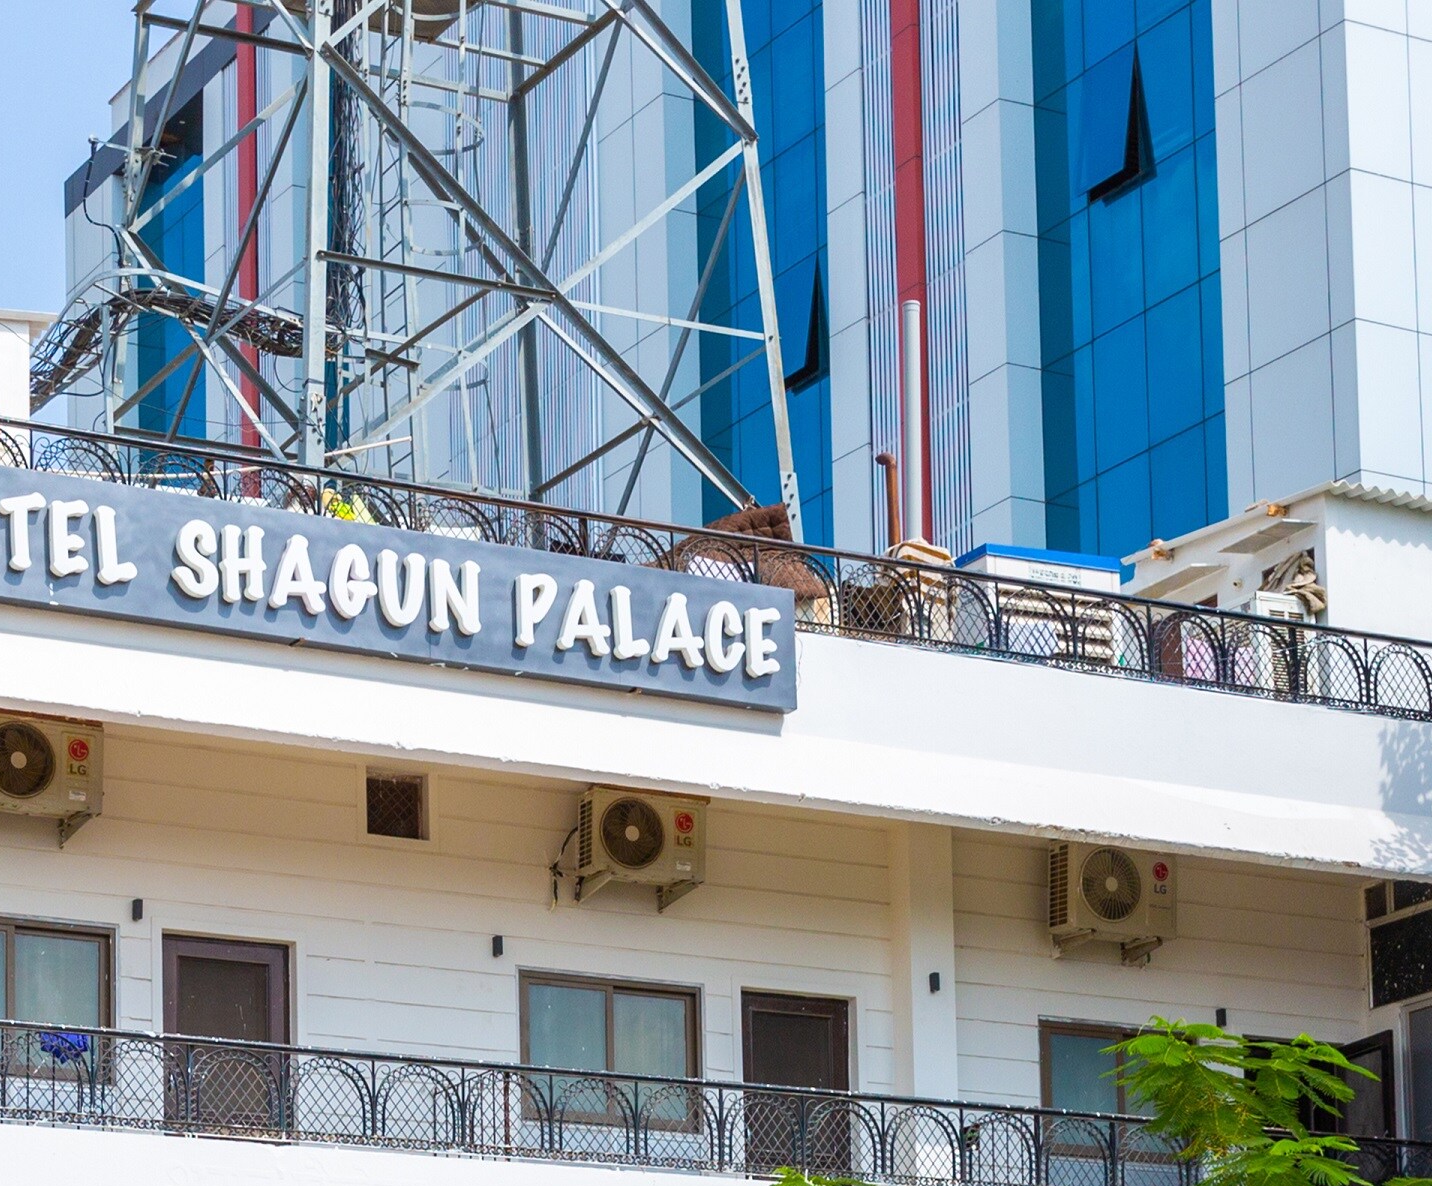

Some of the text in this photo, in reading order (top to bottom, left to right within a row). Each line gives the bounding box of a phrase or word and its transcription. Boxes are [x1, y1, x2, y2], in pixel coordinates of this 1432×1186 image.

[170, 519, 482, 638] SHAGUN
[513, 573, 782, 679] PALACE
[69, 763, 87, 776] LG
[676, 835, 693, 847] LG
[1153, 884, 1167, 895] LG
